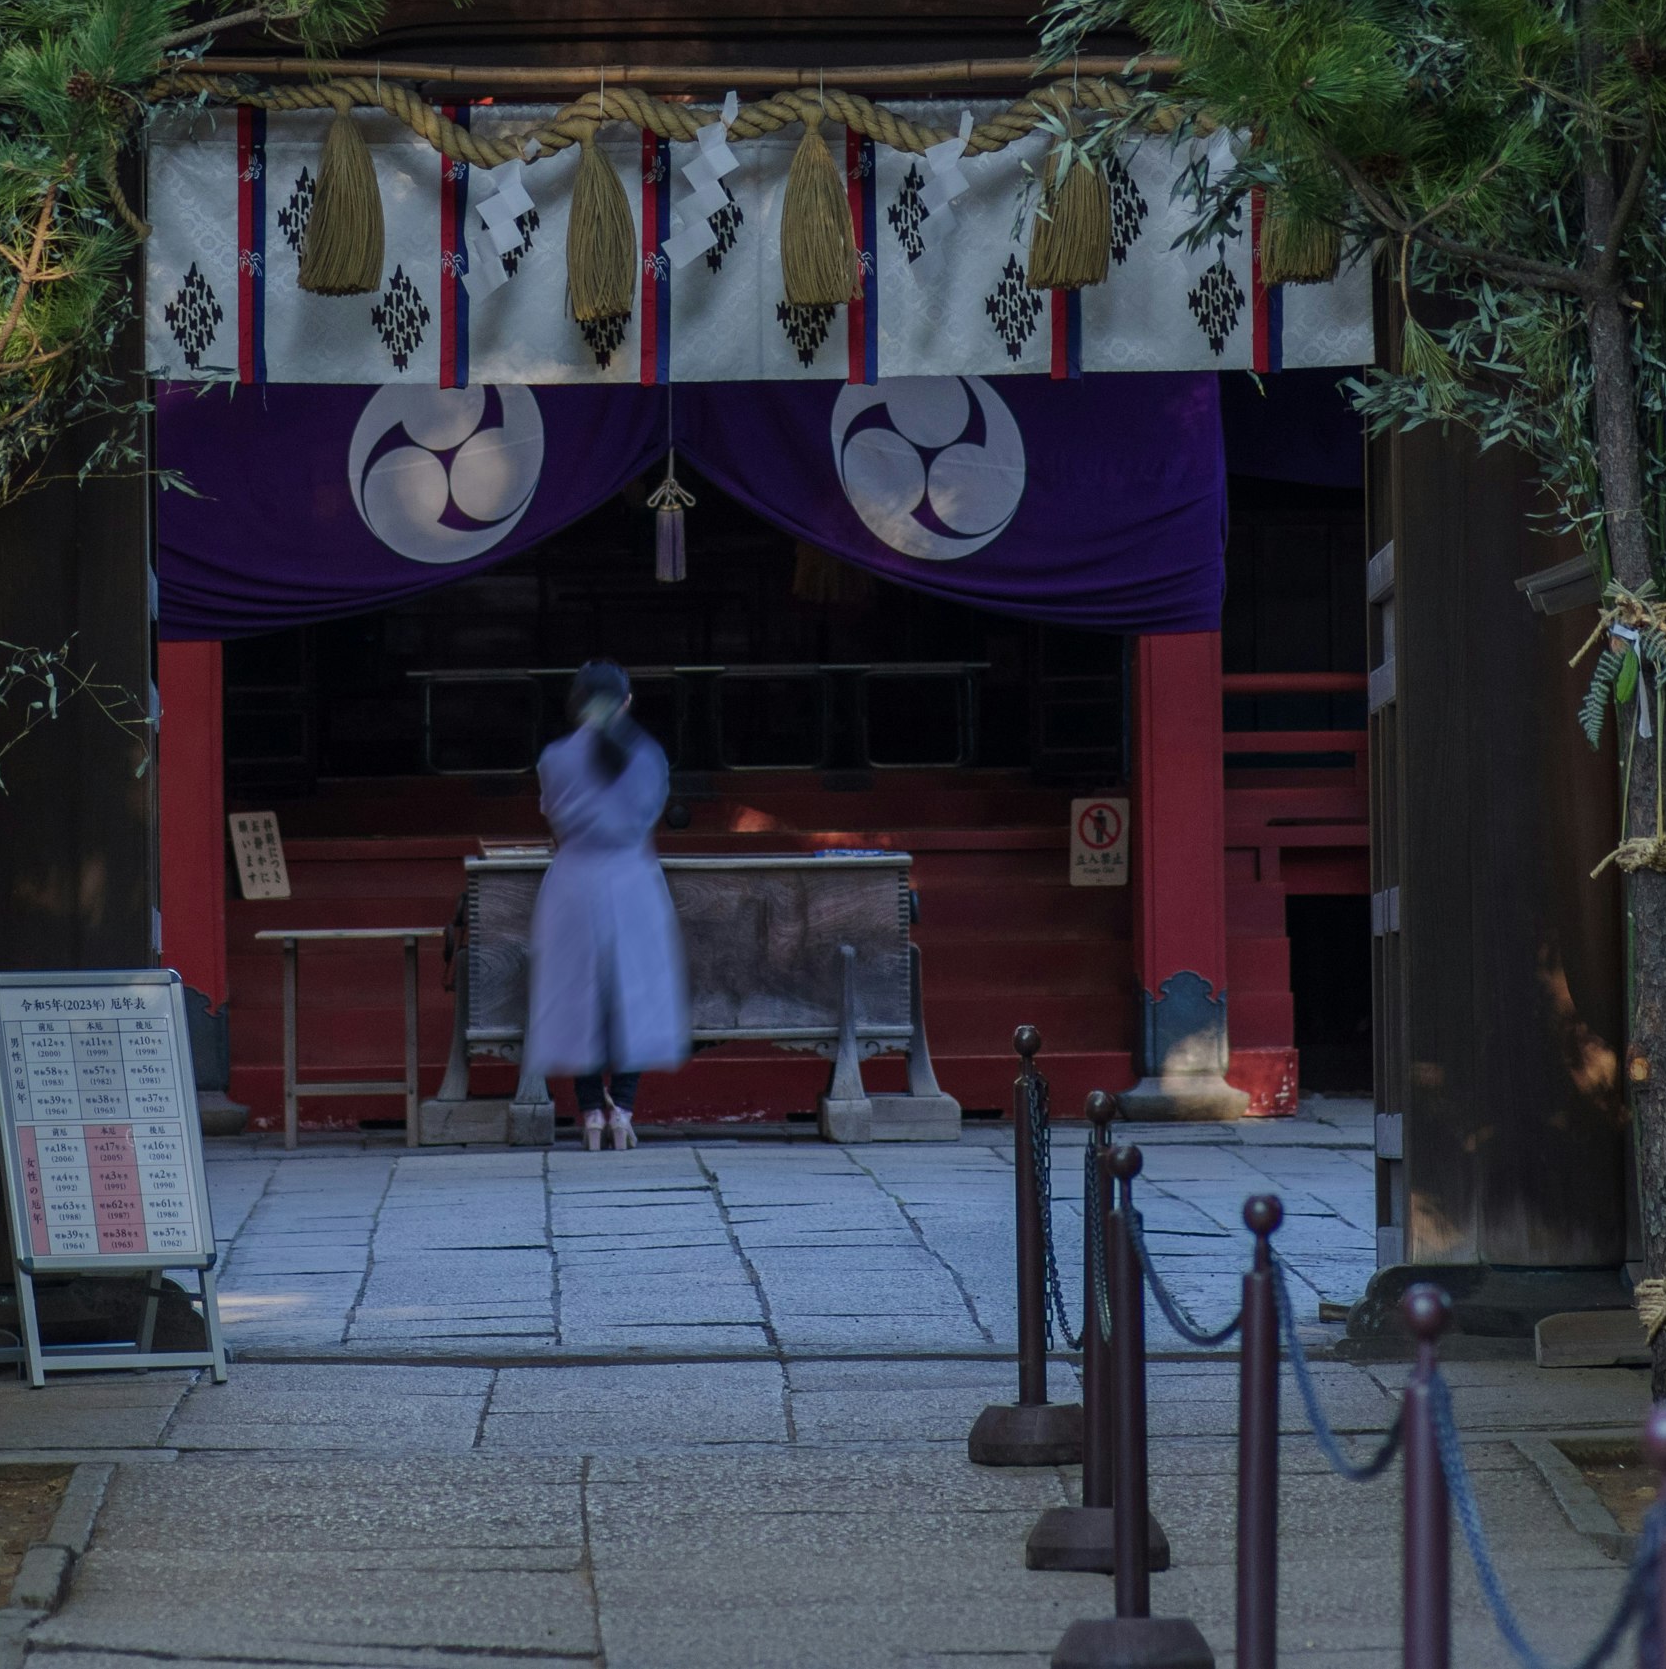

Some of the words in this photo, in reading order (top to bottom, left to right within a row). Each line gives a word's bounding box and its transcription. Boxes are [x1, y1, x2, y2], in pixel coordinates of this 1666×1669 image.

[1075, 853, 1124, 866] 立入禁止
[21, 999, 105, 1012] 令和5年(2023年)
[111, 997, 146, 1010] 厄年表
[10, 1037, 26, 1104] 男性の厄年
[25, 1158, 42, 1224] 女性の厄年
